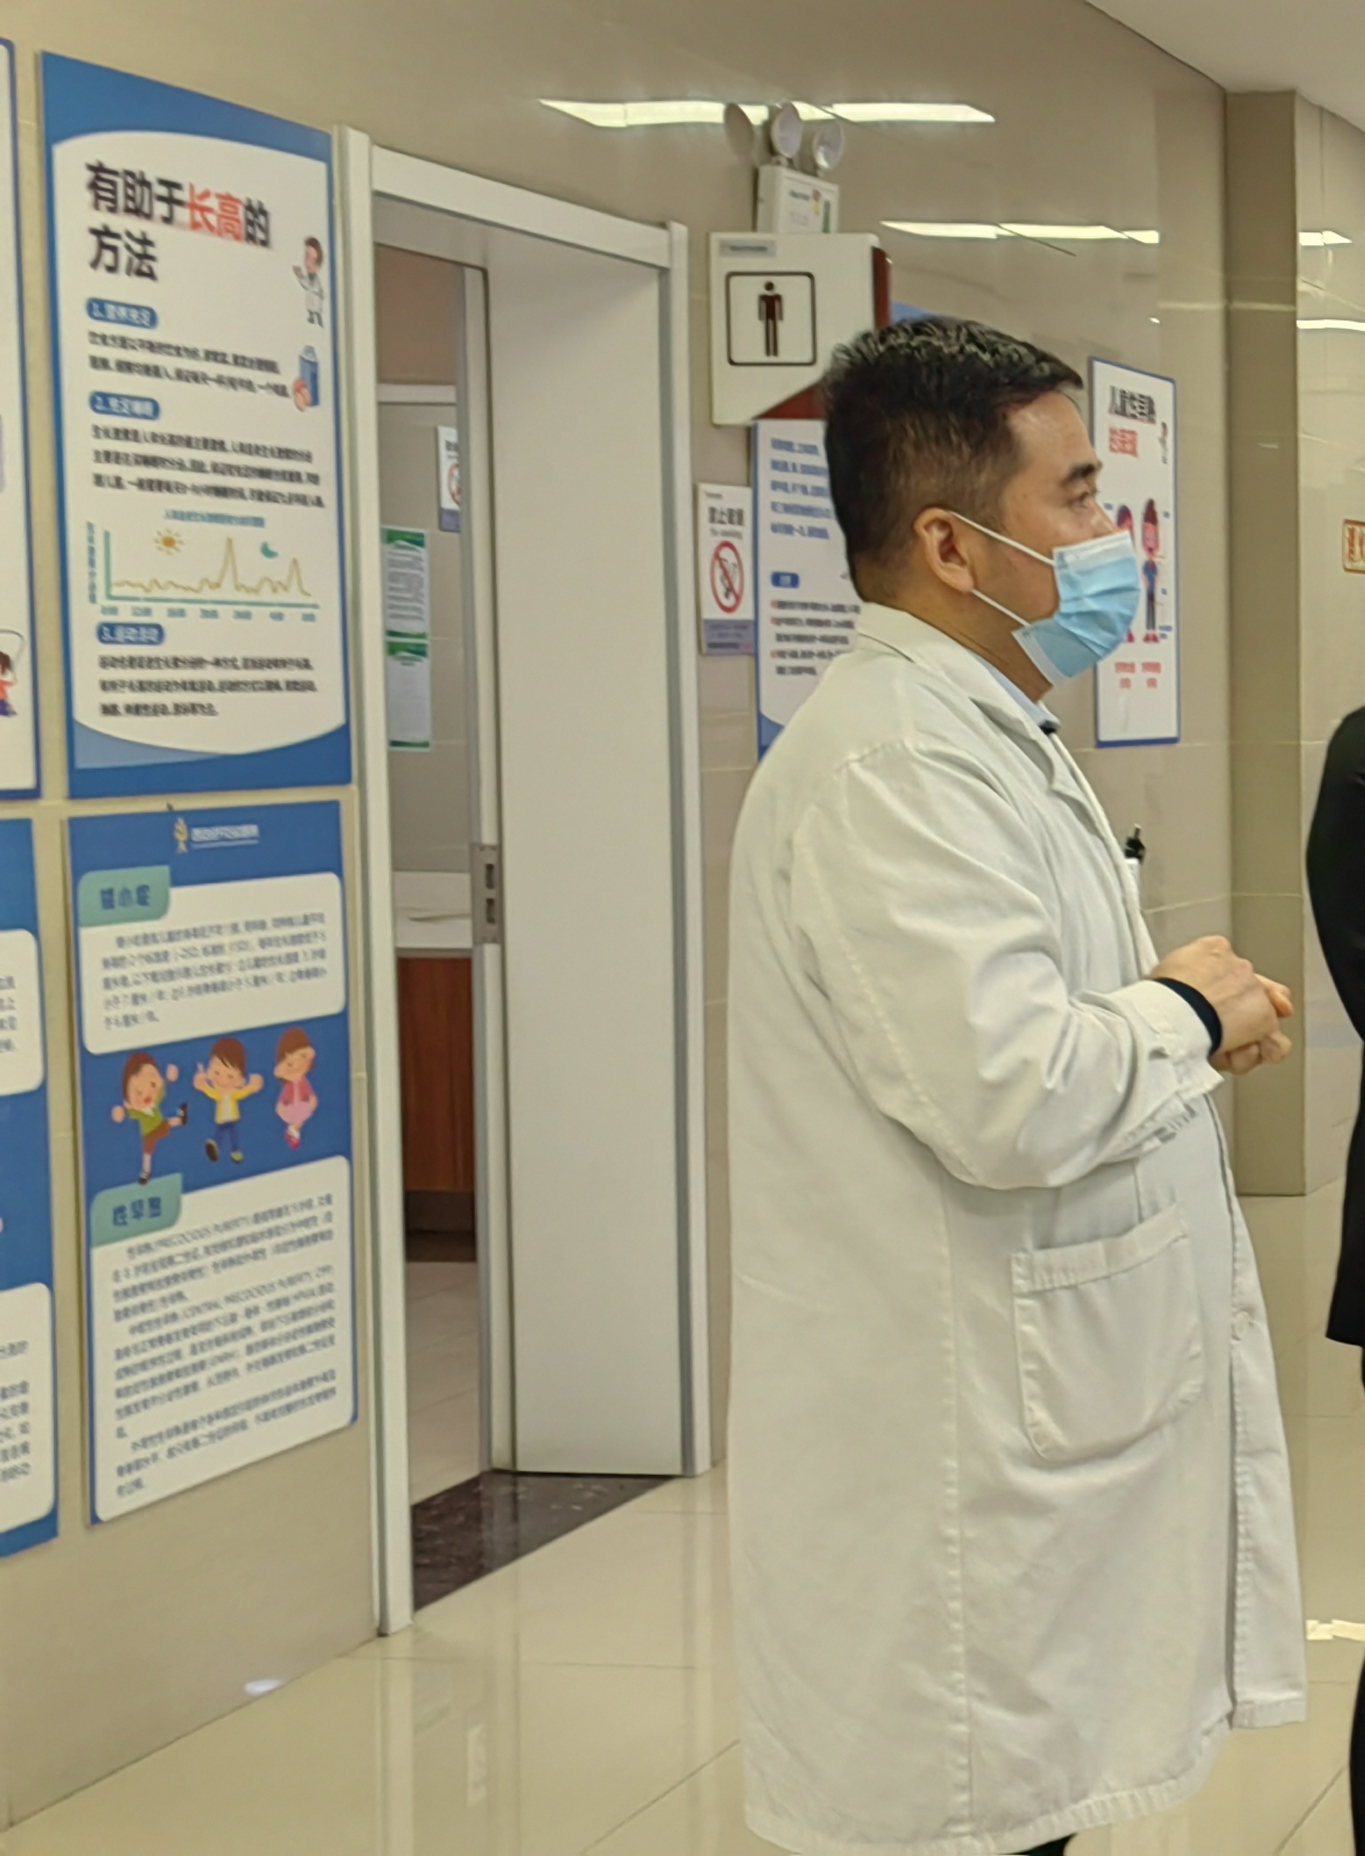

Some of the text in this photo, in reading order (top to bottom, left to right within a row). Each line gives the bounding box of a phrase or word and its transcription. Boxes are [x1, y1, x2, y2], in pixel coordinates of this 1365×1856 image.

[84, 161, 272, 249] 有助于长高的
[89, 225, 158, 281] 方法
